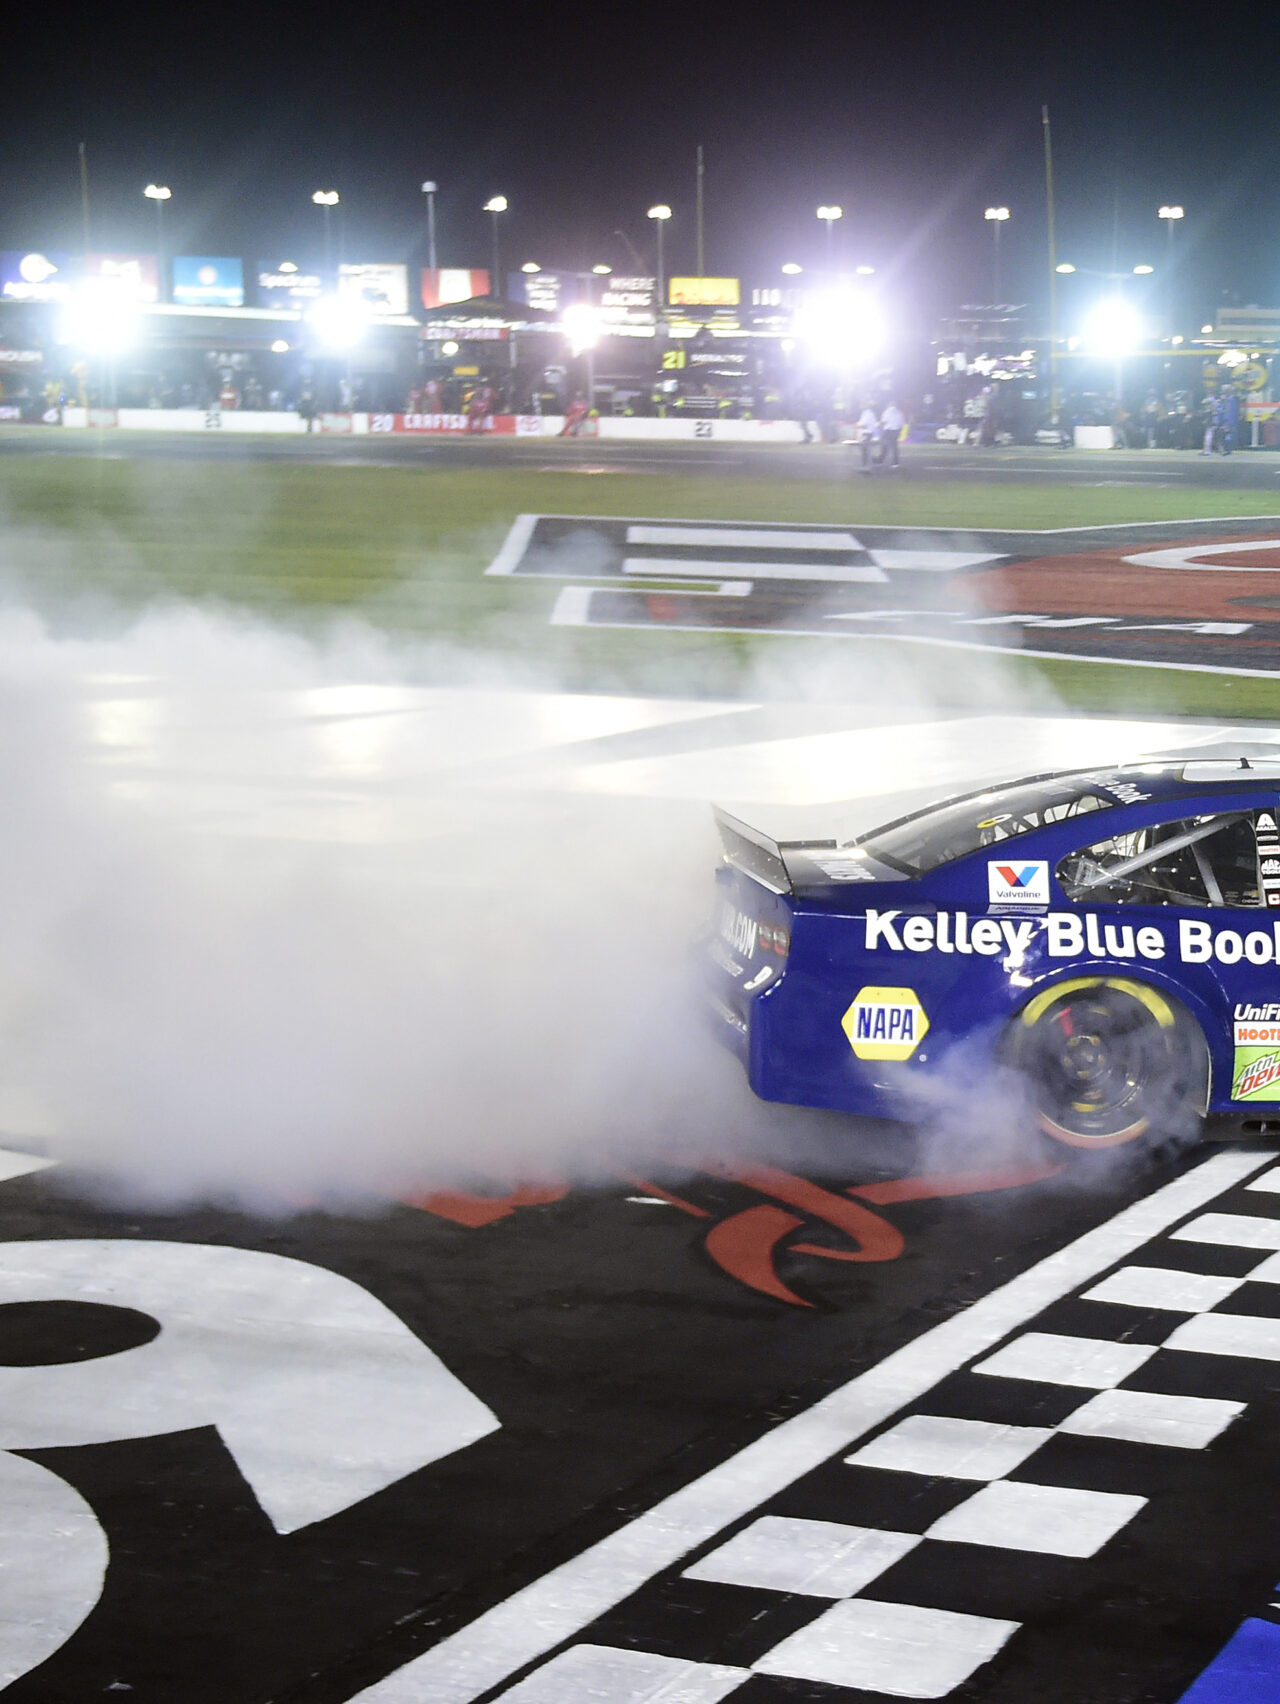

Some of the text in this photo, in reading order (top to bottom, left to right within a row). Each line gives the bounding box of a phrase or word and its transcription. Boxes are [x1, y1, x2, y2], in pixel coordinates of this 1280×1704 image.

[663, 351, 685, 369] 21
[996, 890, 1041, 898] Valvoline
[865, 909, 1033, 968] Kelley
[1047, 912, 1166, 960] Blue
[857, 1007, 914, 1041] NAPA
